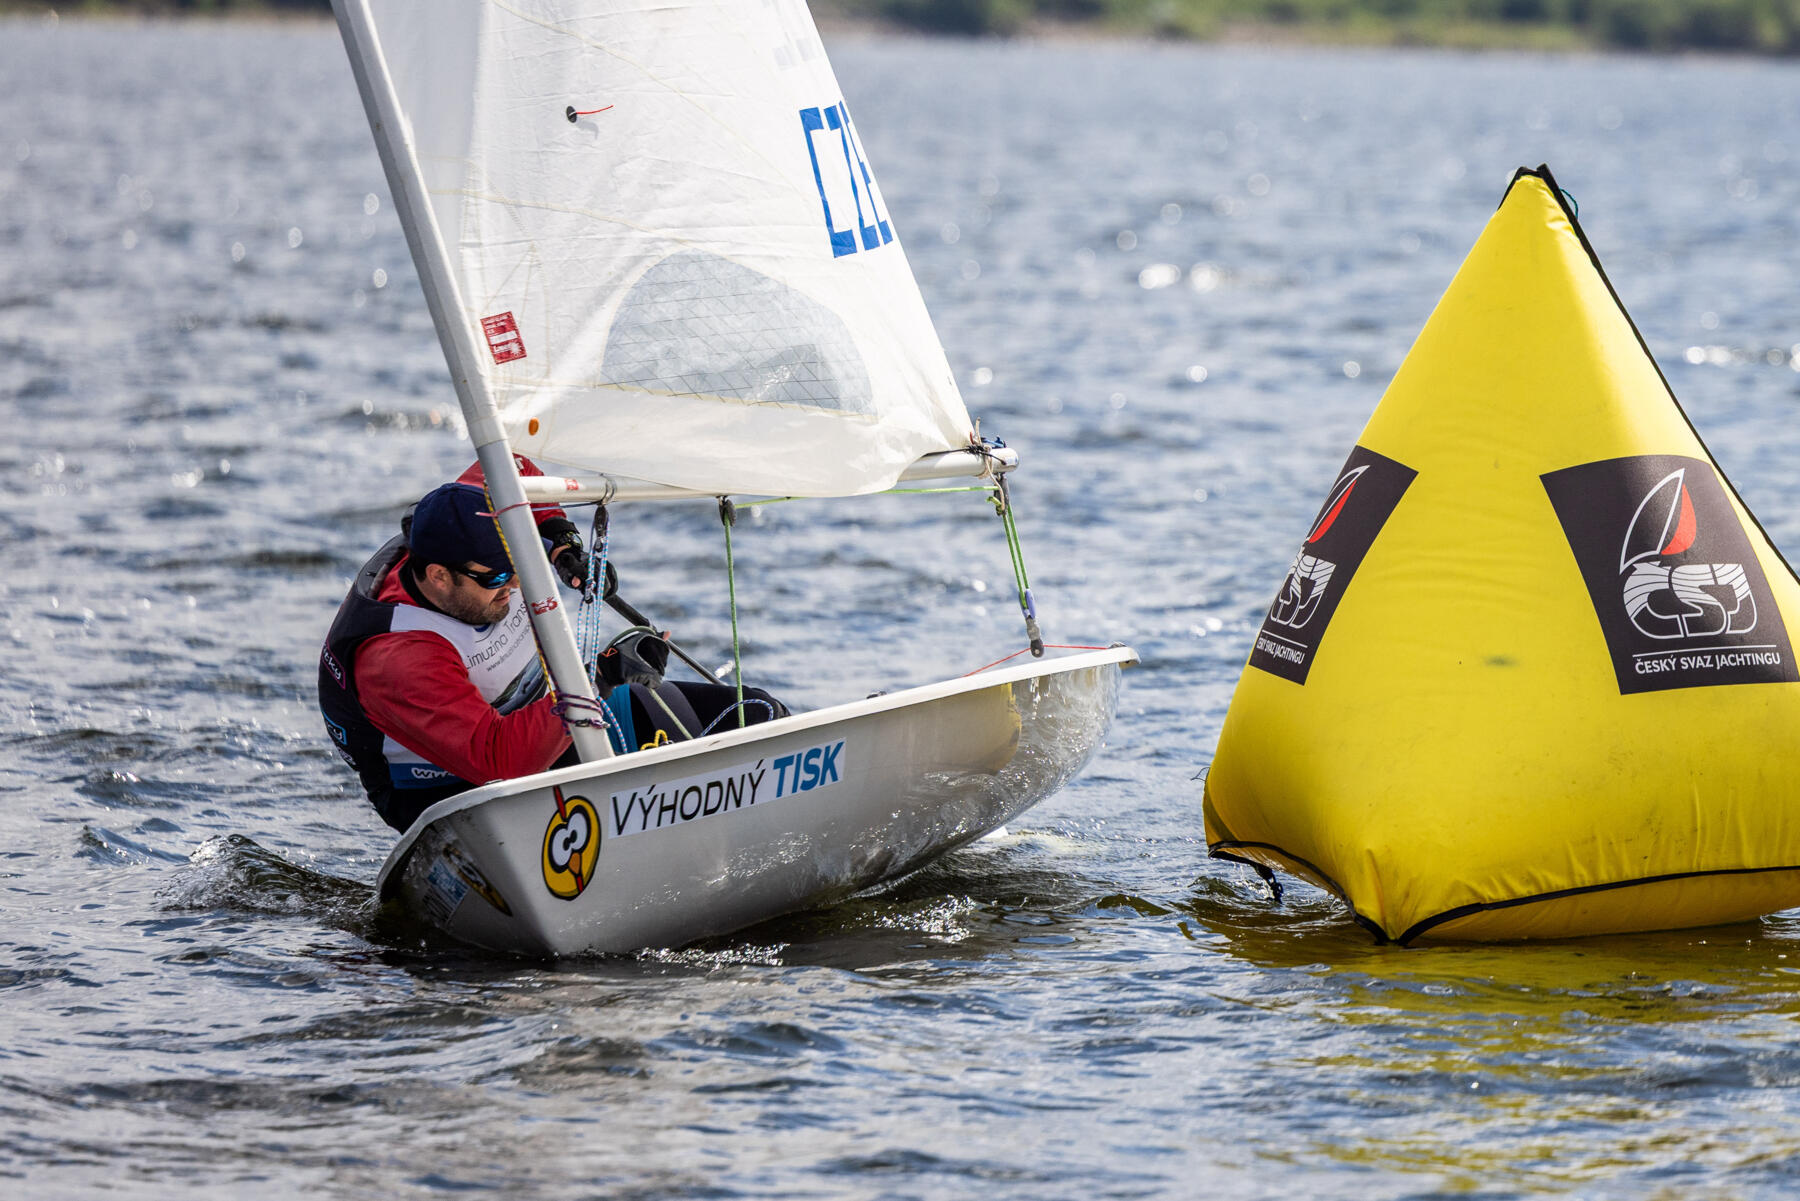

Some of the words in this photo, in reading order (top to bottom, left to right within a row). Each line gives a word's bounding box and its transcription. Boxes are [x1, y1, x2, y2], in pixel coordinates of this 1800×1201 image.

[799, 100, 893, 258] CZE
[503, 600, 527, 634] Trans
[1634, 654, 1677, 675] ČESKÝ
[1680, 654, 1714, 670] SVAZ
[1716, 652, 1781, 671] JACHTINGU
[612, 758, 766, 836] VÝHODNÝ
[773, 741, 844, 798] TISK
